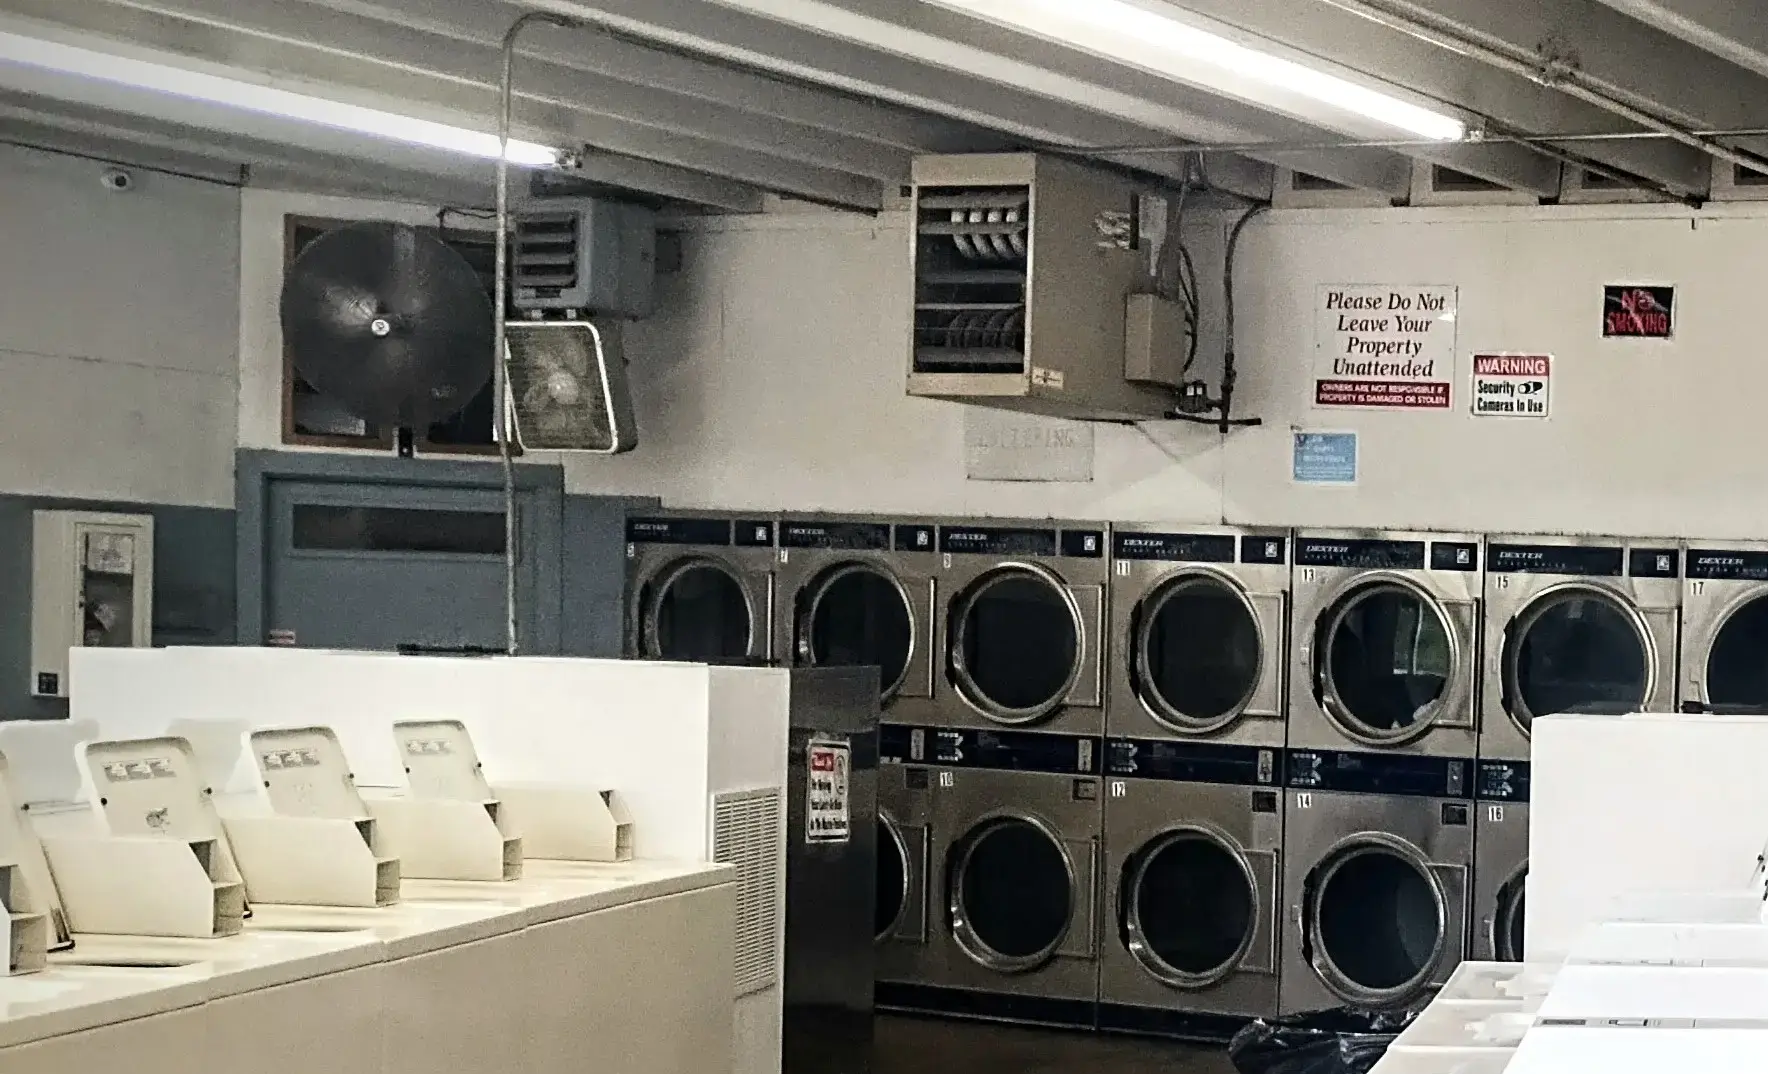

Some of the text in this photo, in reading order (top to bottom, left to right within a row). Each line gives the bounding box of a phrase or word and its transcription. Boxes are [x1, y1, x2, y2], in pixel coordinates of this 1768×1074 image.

[1326, 292, 1445, 311] Please Do Not
[1621, 289, 1656, 311] NO
[1337, 314, 1433, 333] Leave Your
[1606, 311, 1667, 334] SMOKING
[1346, 336, 1423, 358] Property
[1332, 358, 1434, 378] Unattended
[1477, 358, 1547, 374] WARNING
[1355, 384, 1370, 393] ARE
[1371, 384, 1387, 393] NOT
[1477, 379, 1516, 398] Security
[1319, 393, 1357, 402] PROPERTY
[1366, 394, 1404, 403] DAMAGED
[1404, 395, 1417, 404] OR
[1418, 396, 1447, 405] STOLEN
[1477, 397, 1543, 413] Cameras In Use
[1306, 545, 1349, 553] DEXTER
[1499, 551, 1544, 559] DEXTER
[1118, 561, 1129, 576] 11
[1698, 557, 1744, 565] DEXTER
[1303, 568, 1314, 581] 13
[1496, 575, 1508, 589] 15
[1692, 581, 1704, 596] 17
[1299, 794, 1310, 808] 14
[1490, 807, 1502, 820] 16
